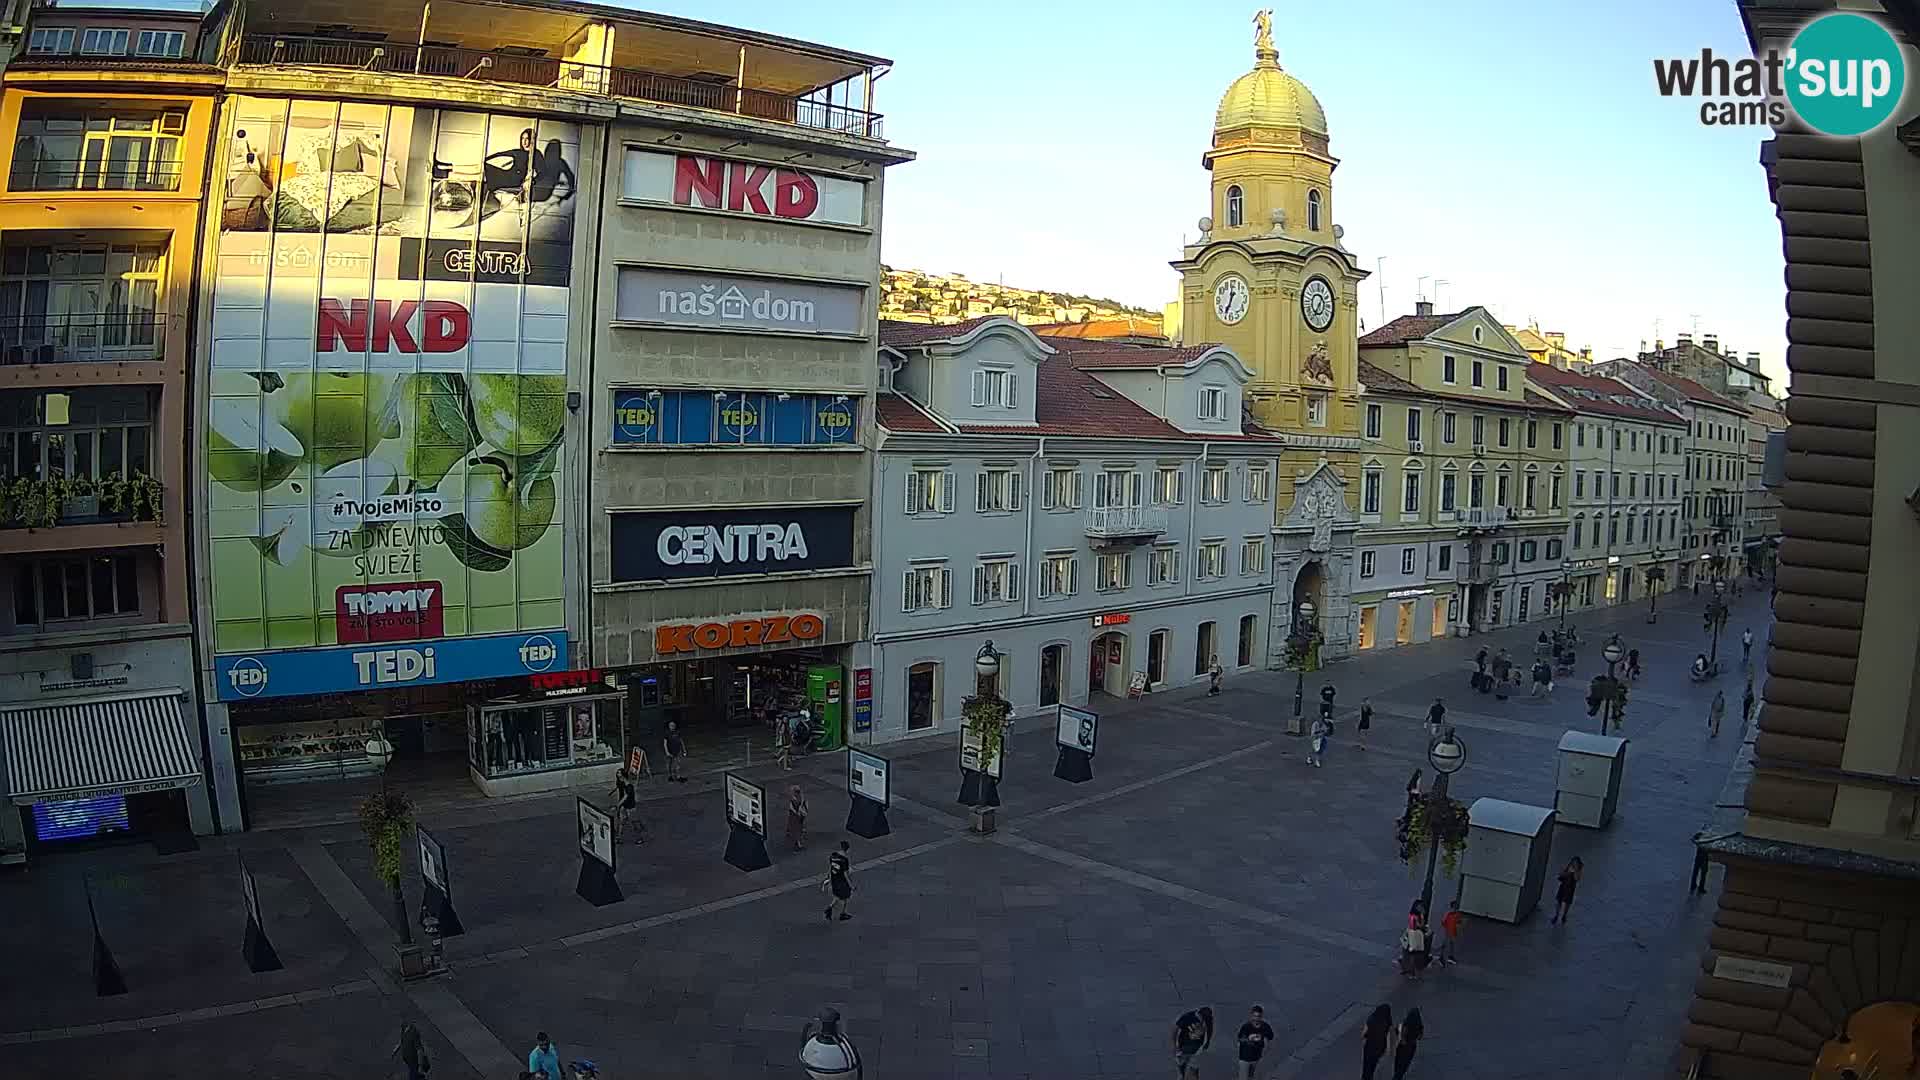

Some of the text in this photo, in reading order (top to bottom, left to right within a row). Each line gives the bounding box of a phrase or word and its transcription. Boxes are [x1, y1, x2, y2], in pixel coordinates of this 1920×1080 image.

[673, 153, 819, 219] NKD
[444, 249, 531, 275] CENTRA
[659, 284, 815, 323] naš dom
[317, 298, 472, 353] NKD
[616, 408, 655, 425] TEDi
[721, 409, 757, 426] TEDi
[818, 411, 851, 427] TEDi
[333, 498, 442, 519] #TvojeMisto
[329, 525, 447, 550] ZA DNEVNO
[657, 522, 808, 565] CENTRA
[354, 550, 422, 576] SVJEŽE
[343, 588, 435, 615] TOMMY
[656, 614, 824, 654] KORZO
[353, 647, 435, 685] TEDi
[519, 643, 556, 664] TEDi
[229, 667, 268, 687] TEDi
